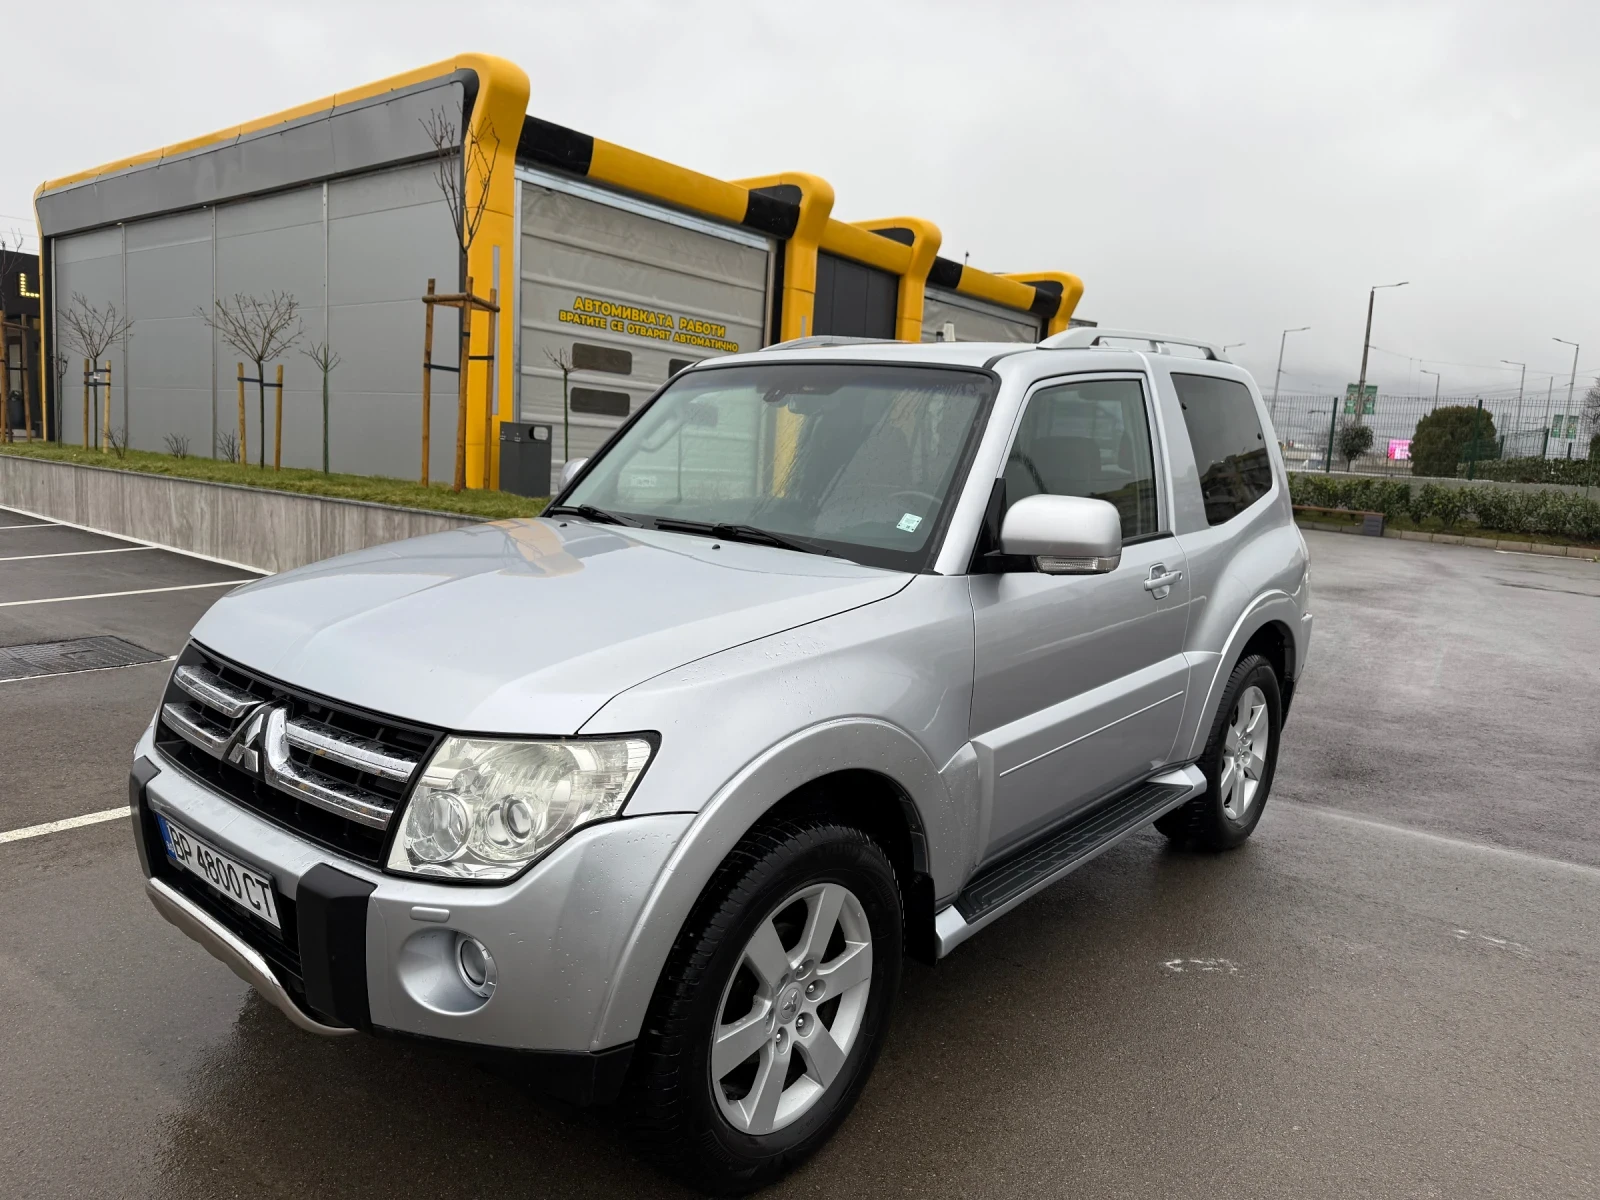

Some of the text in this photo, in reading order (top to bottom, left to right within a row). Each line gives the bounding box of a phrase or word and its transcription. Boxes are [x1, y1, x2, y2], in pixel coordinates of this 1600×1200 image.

[558, 309, 739, 352] ВРАТИТЕ СЕ ОТВАРЯТ АВТОМАТИЧНО
[573, 296, 726, 338] АВТОМИВКАТА РАБОТИ
